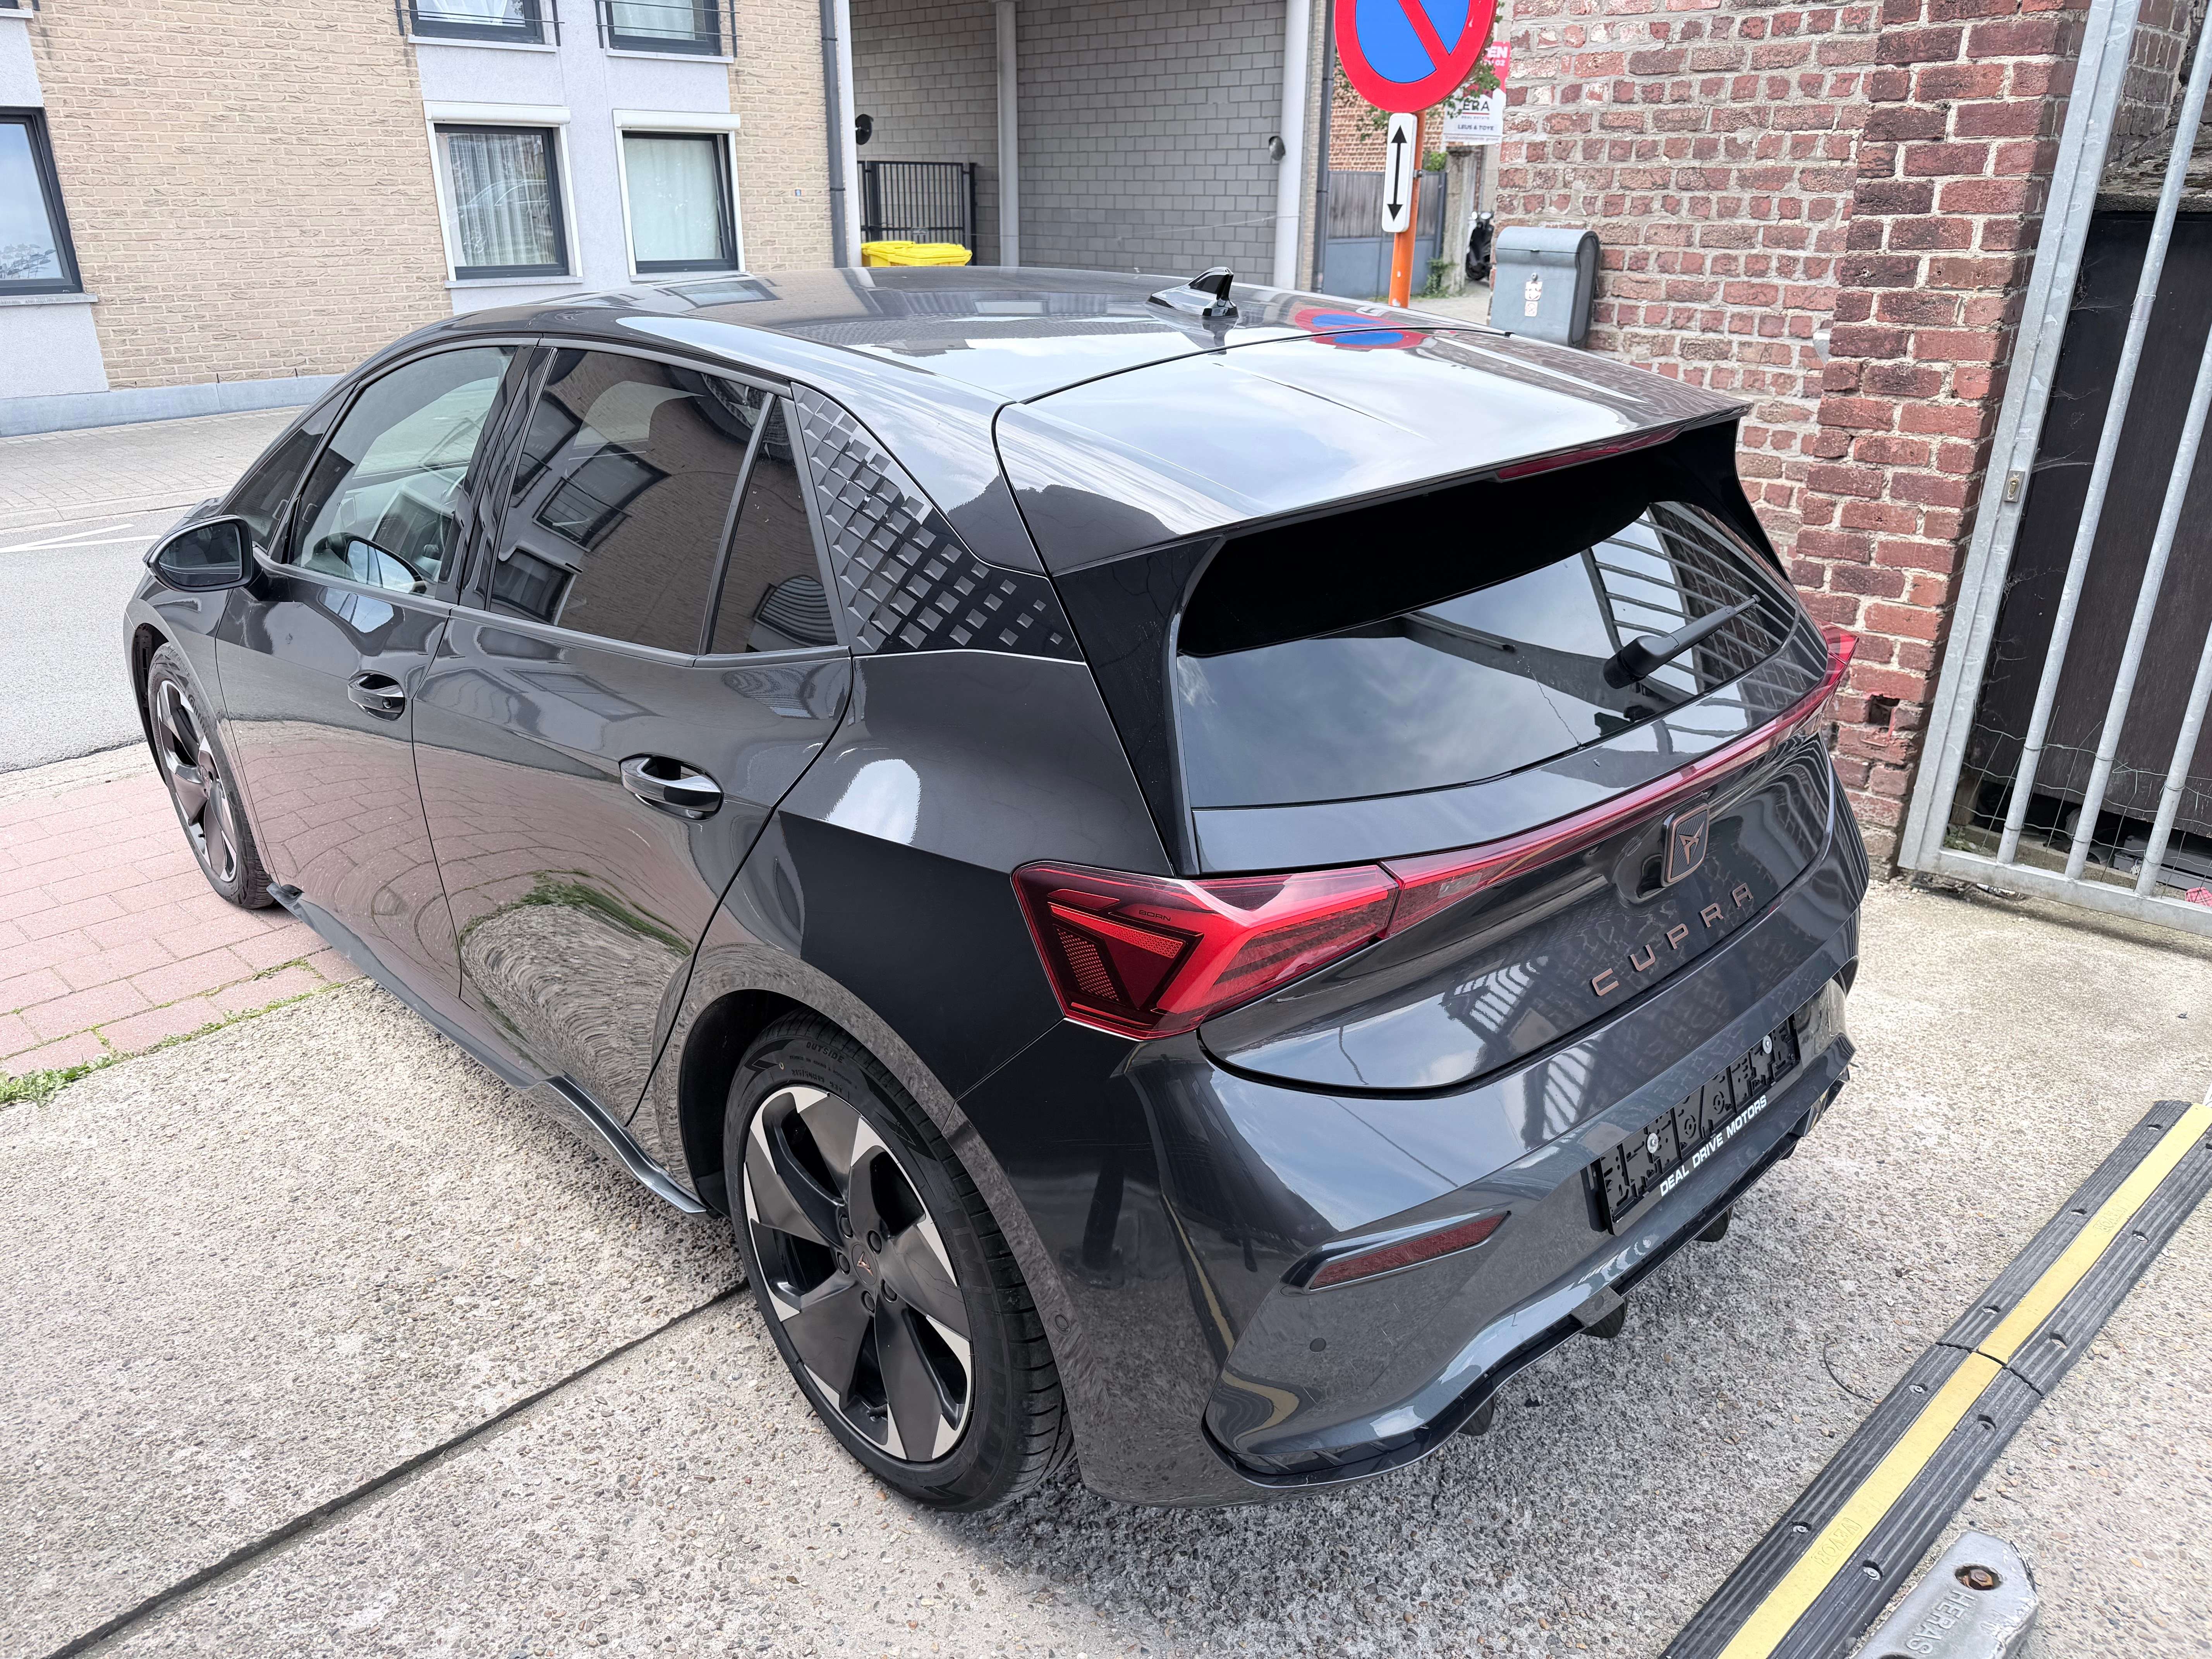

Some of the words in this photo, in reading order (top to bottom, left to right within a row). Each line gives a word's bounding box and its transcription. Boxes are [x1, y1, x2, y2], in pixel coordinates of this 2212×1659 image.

[1463, 99, 1489, 111] ERA
[1139, 910, 1171, 921] BORN
[1592, 883, 1753, 996] CUPRA
[806, 1041, 845, 1063] OUTSIDE
[1659, 1167, 1689, 1197] DEAL
[1692, 1132, 1724, 1168] DRIVE
[1726, 1094, 1767, 1137] MOTORS
[1906, 1590, 1977, 1655] HERAS
